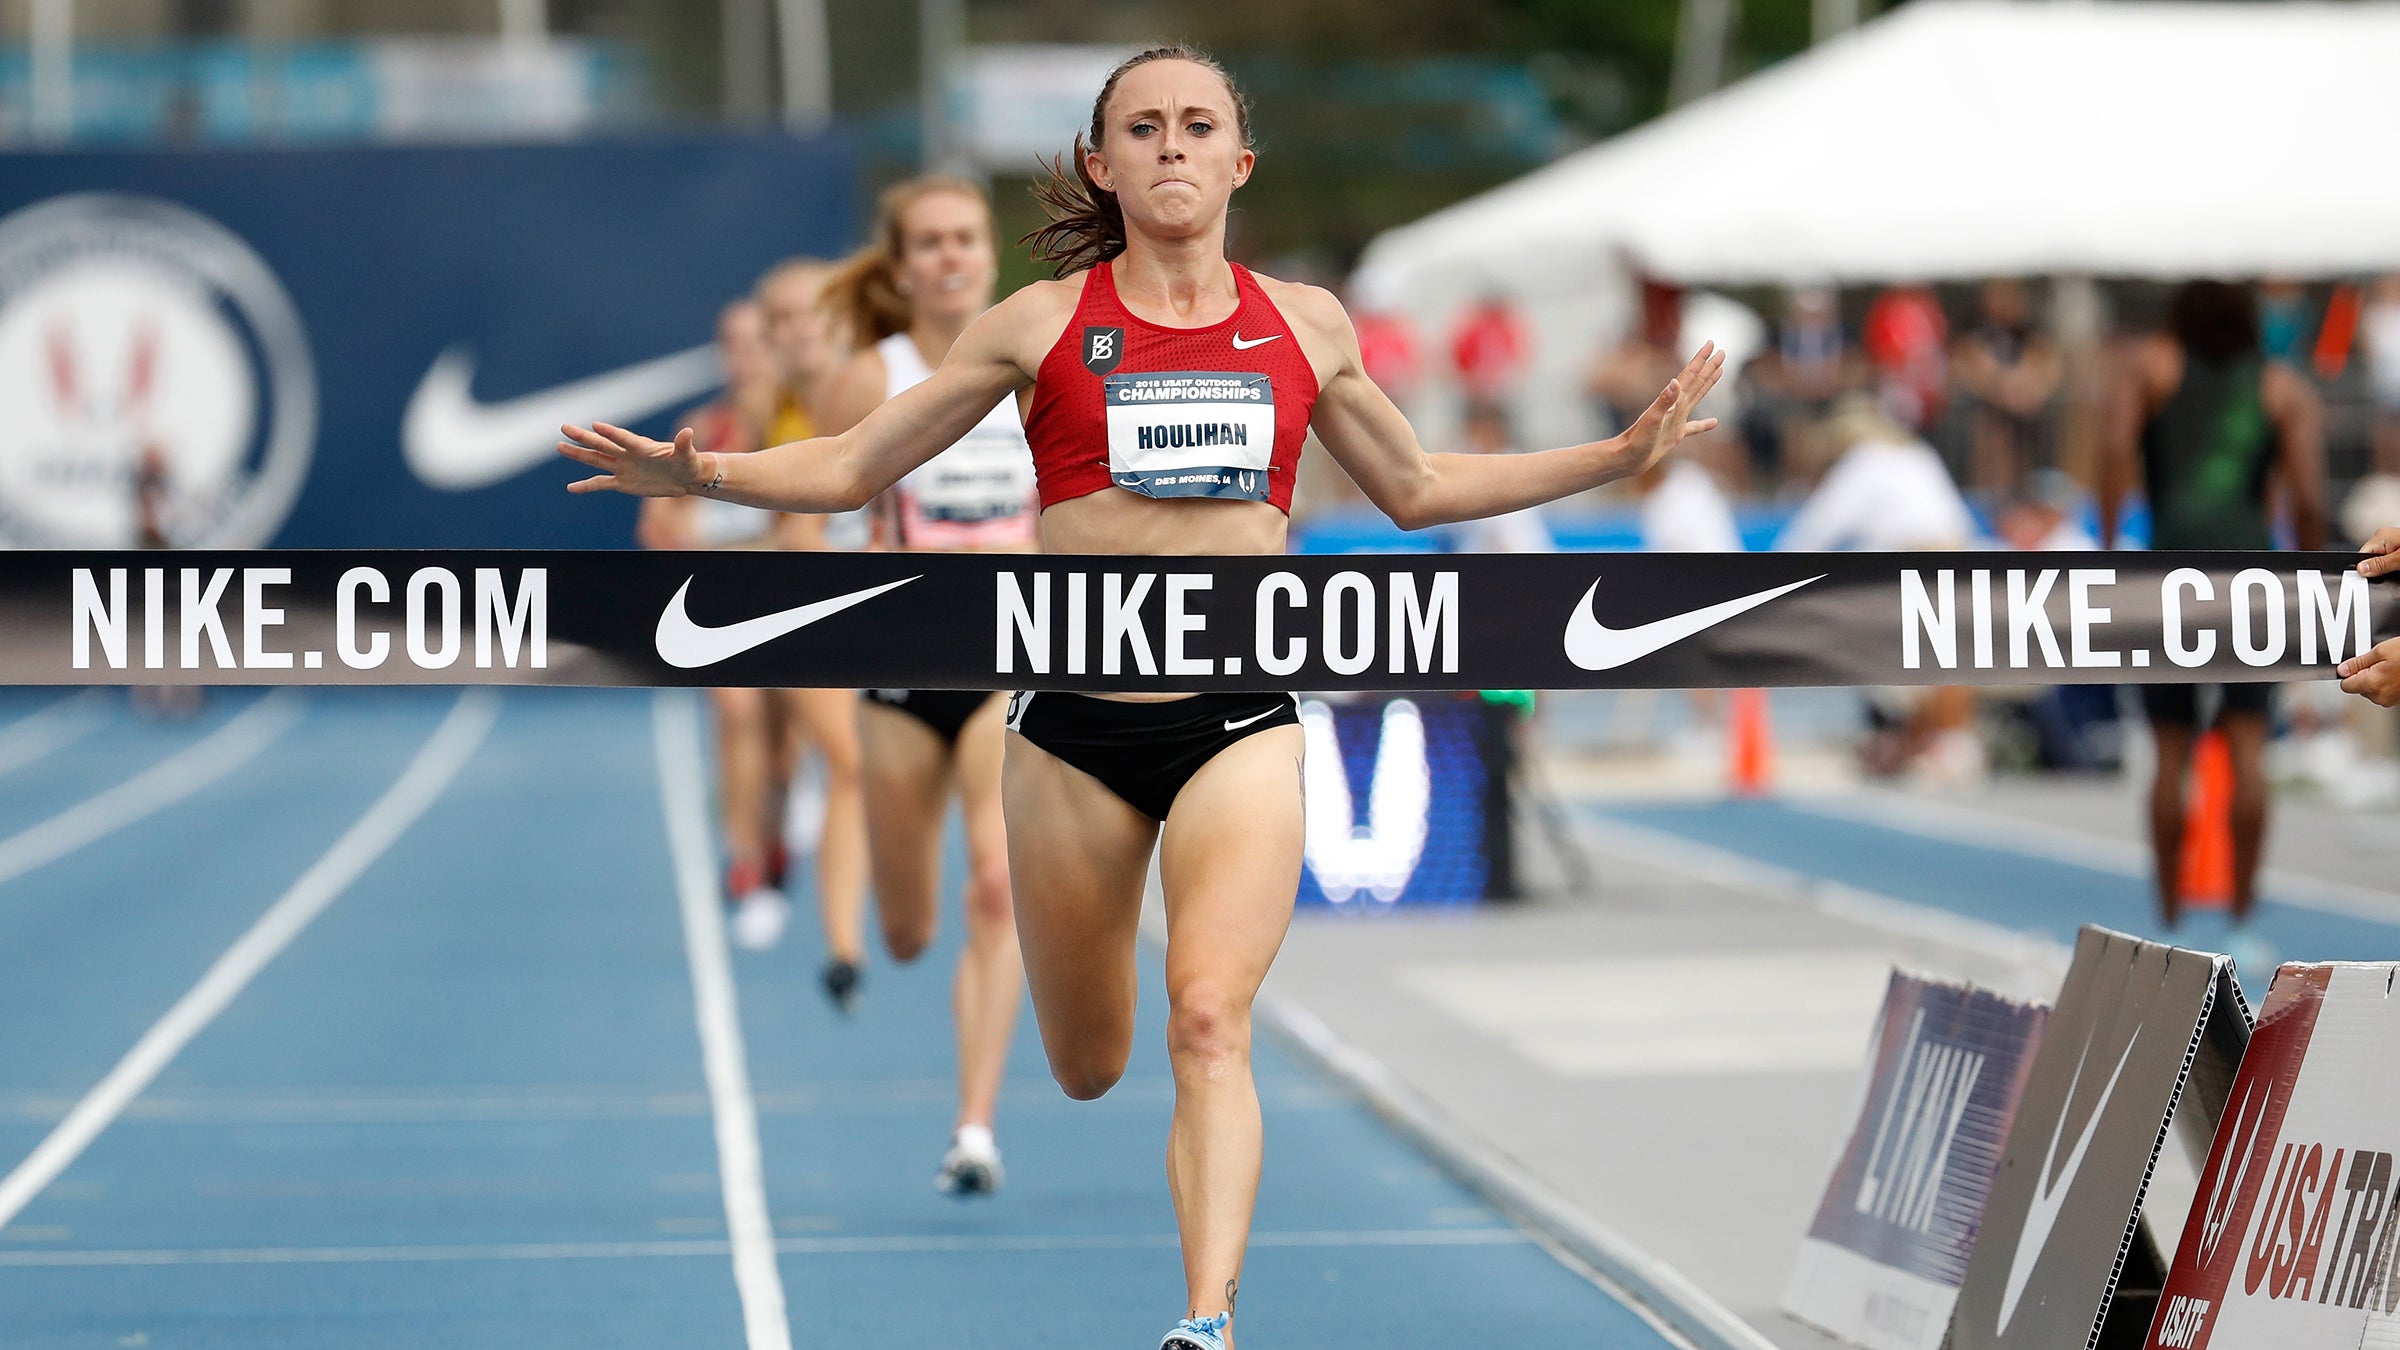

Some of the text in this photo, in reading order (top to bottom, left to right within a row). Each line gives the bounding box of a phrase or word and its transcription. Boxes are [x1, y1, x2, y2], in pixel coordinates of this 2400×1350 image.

[1118, 386, 1262, 402] CHAMPIONSHIPS
[1135, 379, 1242, 388] 2018 USATF OUTDOOR
[1137, 423, 1247, 450] HOULIHAN
[1154, 475, 1231, 486] DES MOINES, IA
[73, 567, 548, 670] NIKE.COM
[996, 571, 1459, 676] NIKE.COM
[1900, 567, 2372, 669] NIKE.COM
[1856, 1006, 1986, 1235] LYNX
[2158, 1295, 2211, 1350] USATF
